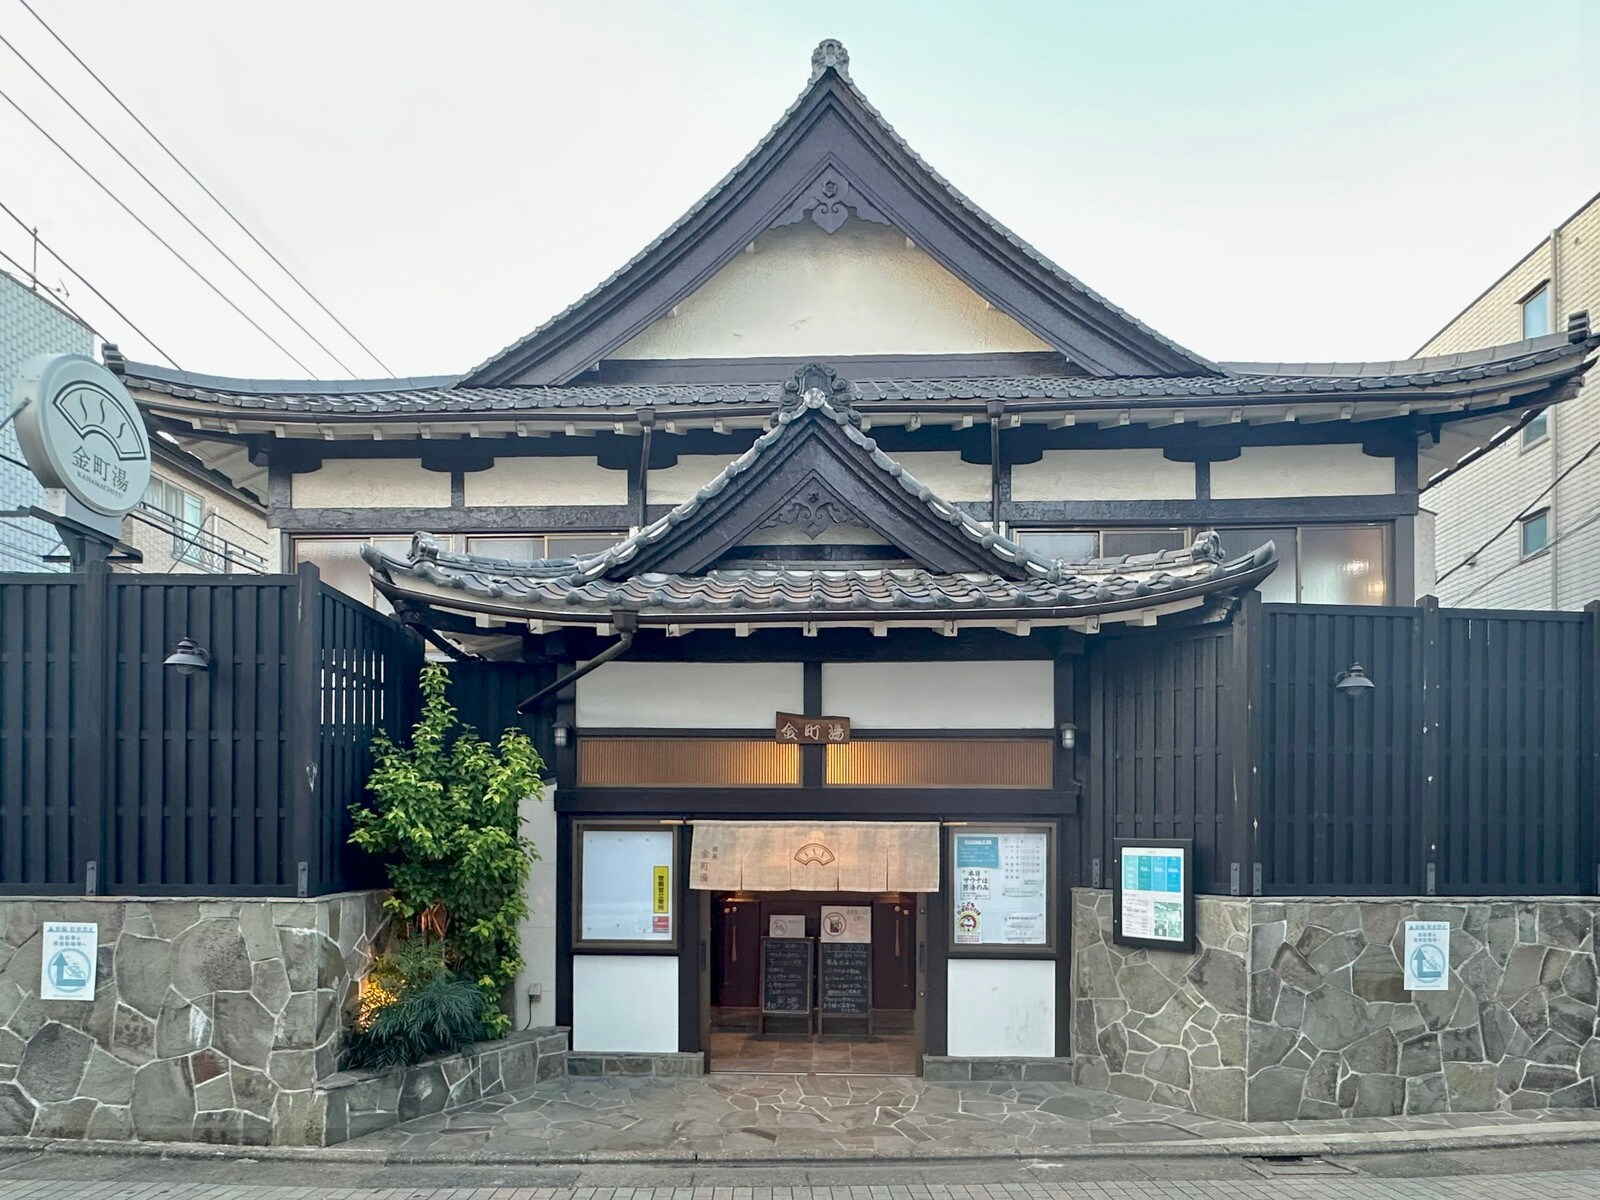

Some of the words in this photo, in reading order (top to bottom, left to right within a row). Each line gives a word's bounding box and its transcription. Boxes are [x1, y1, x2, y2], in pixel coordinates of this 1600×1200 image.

[72, 446, 128, 492] 金町湯
[781, 722, 844, 740] 金町湯
[700, 849, 709, 882] 金町湯
